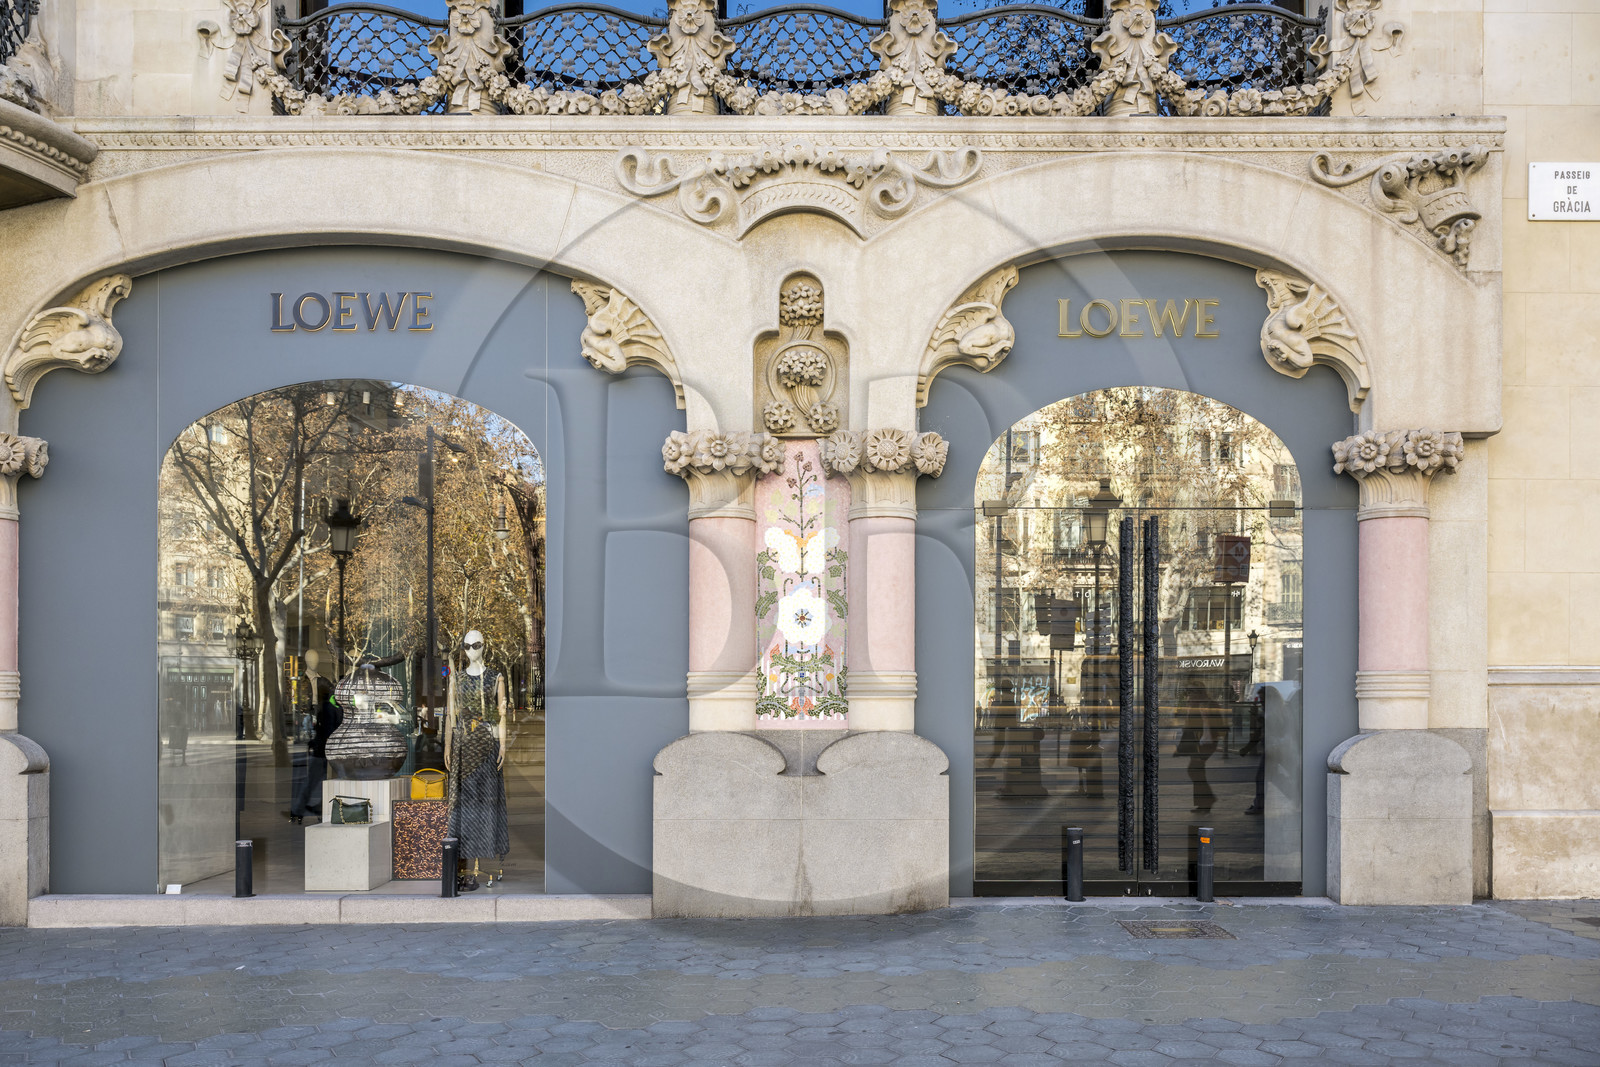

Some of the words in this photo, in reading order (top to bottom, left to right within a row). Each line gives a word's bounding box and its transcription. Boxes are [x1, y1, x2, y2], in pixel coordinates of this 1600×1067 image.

[1554, 170, 1591, 179] PASSEIG
[1567, 185, 1578, 195] DE
[1553, 197, 1591, 213] GRÀCIA
[270, 291, 434, 333] LOEWE
[1057, 298, 1220, 339] LOEWE
